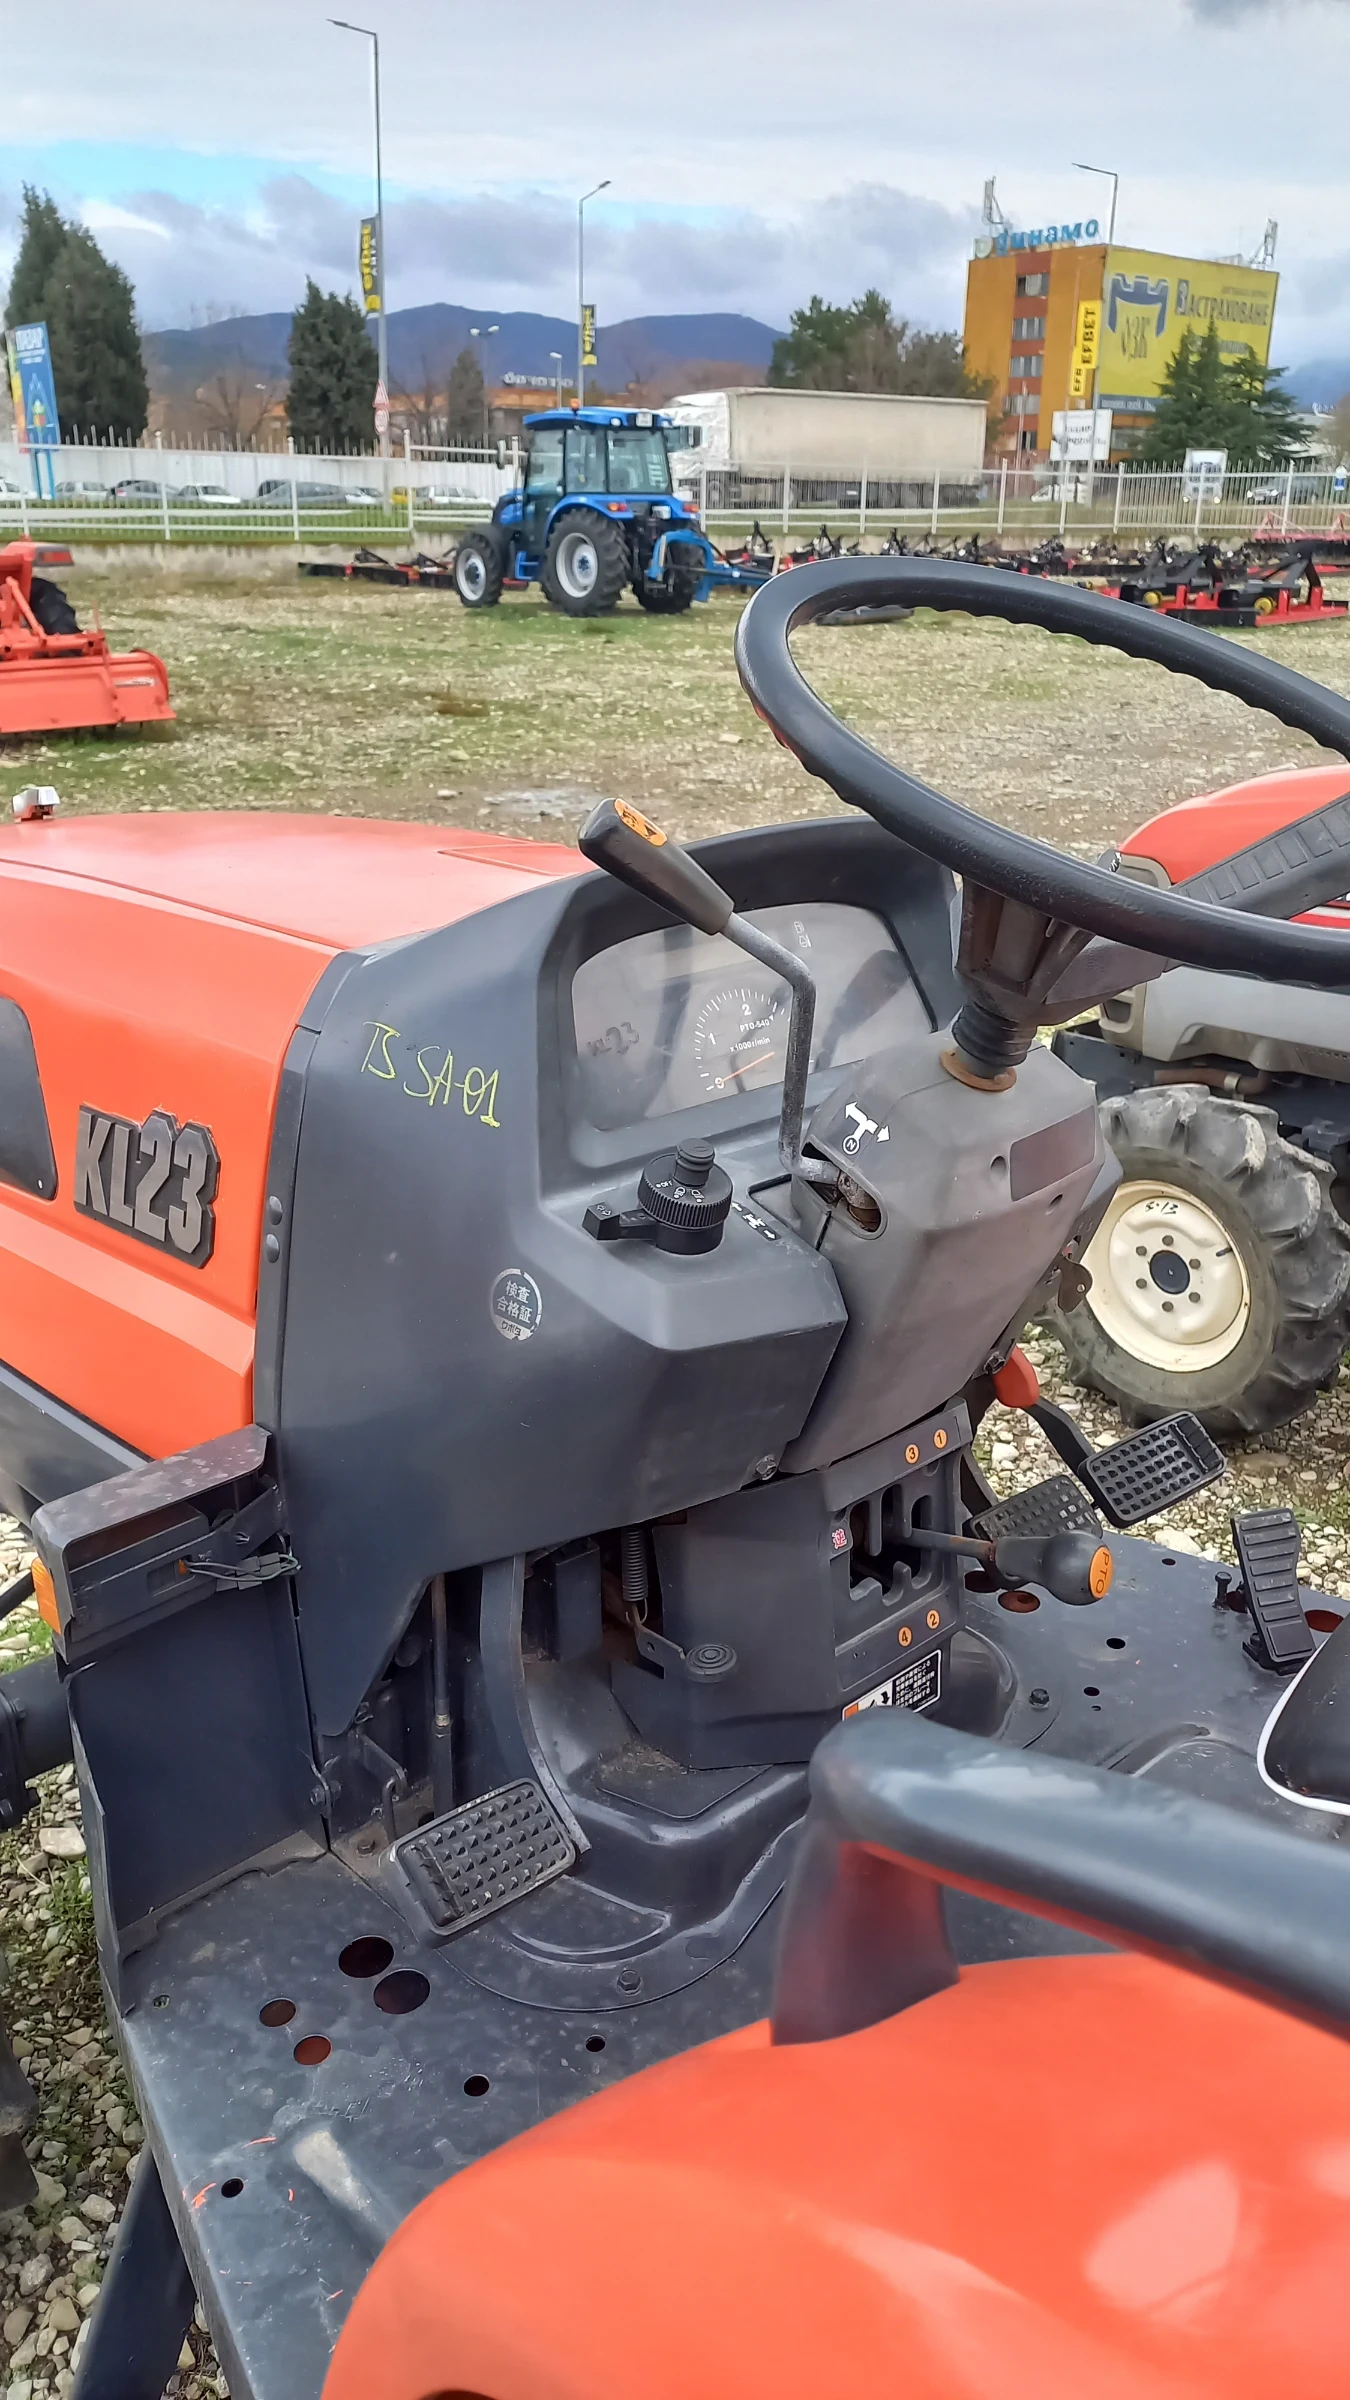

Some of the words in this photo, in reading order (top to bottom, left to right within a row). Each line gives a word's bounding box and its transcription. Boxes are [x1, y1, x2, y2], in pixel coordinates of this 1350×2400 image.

[741, 1003, 752, 1016] 2
[739, 1018, 770, 1032] PTO-540
[708, 1032, 717, 1045] 1
[74, 1109, 208, 1255] KL23
[497, 1295, 533, 1324] 合格証
[1095, 1551, 1110, 1594] PTO
